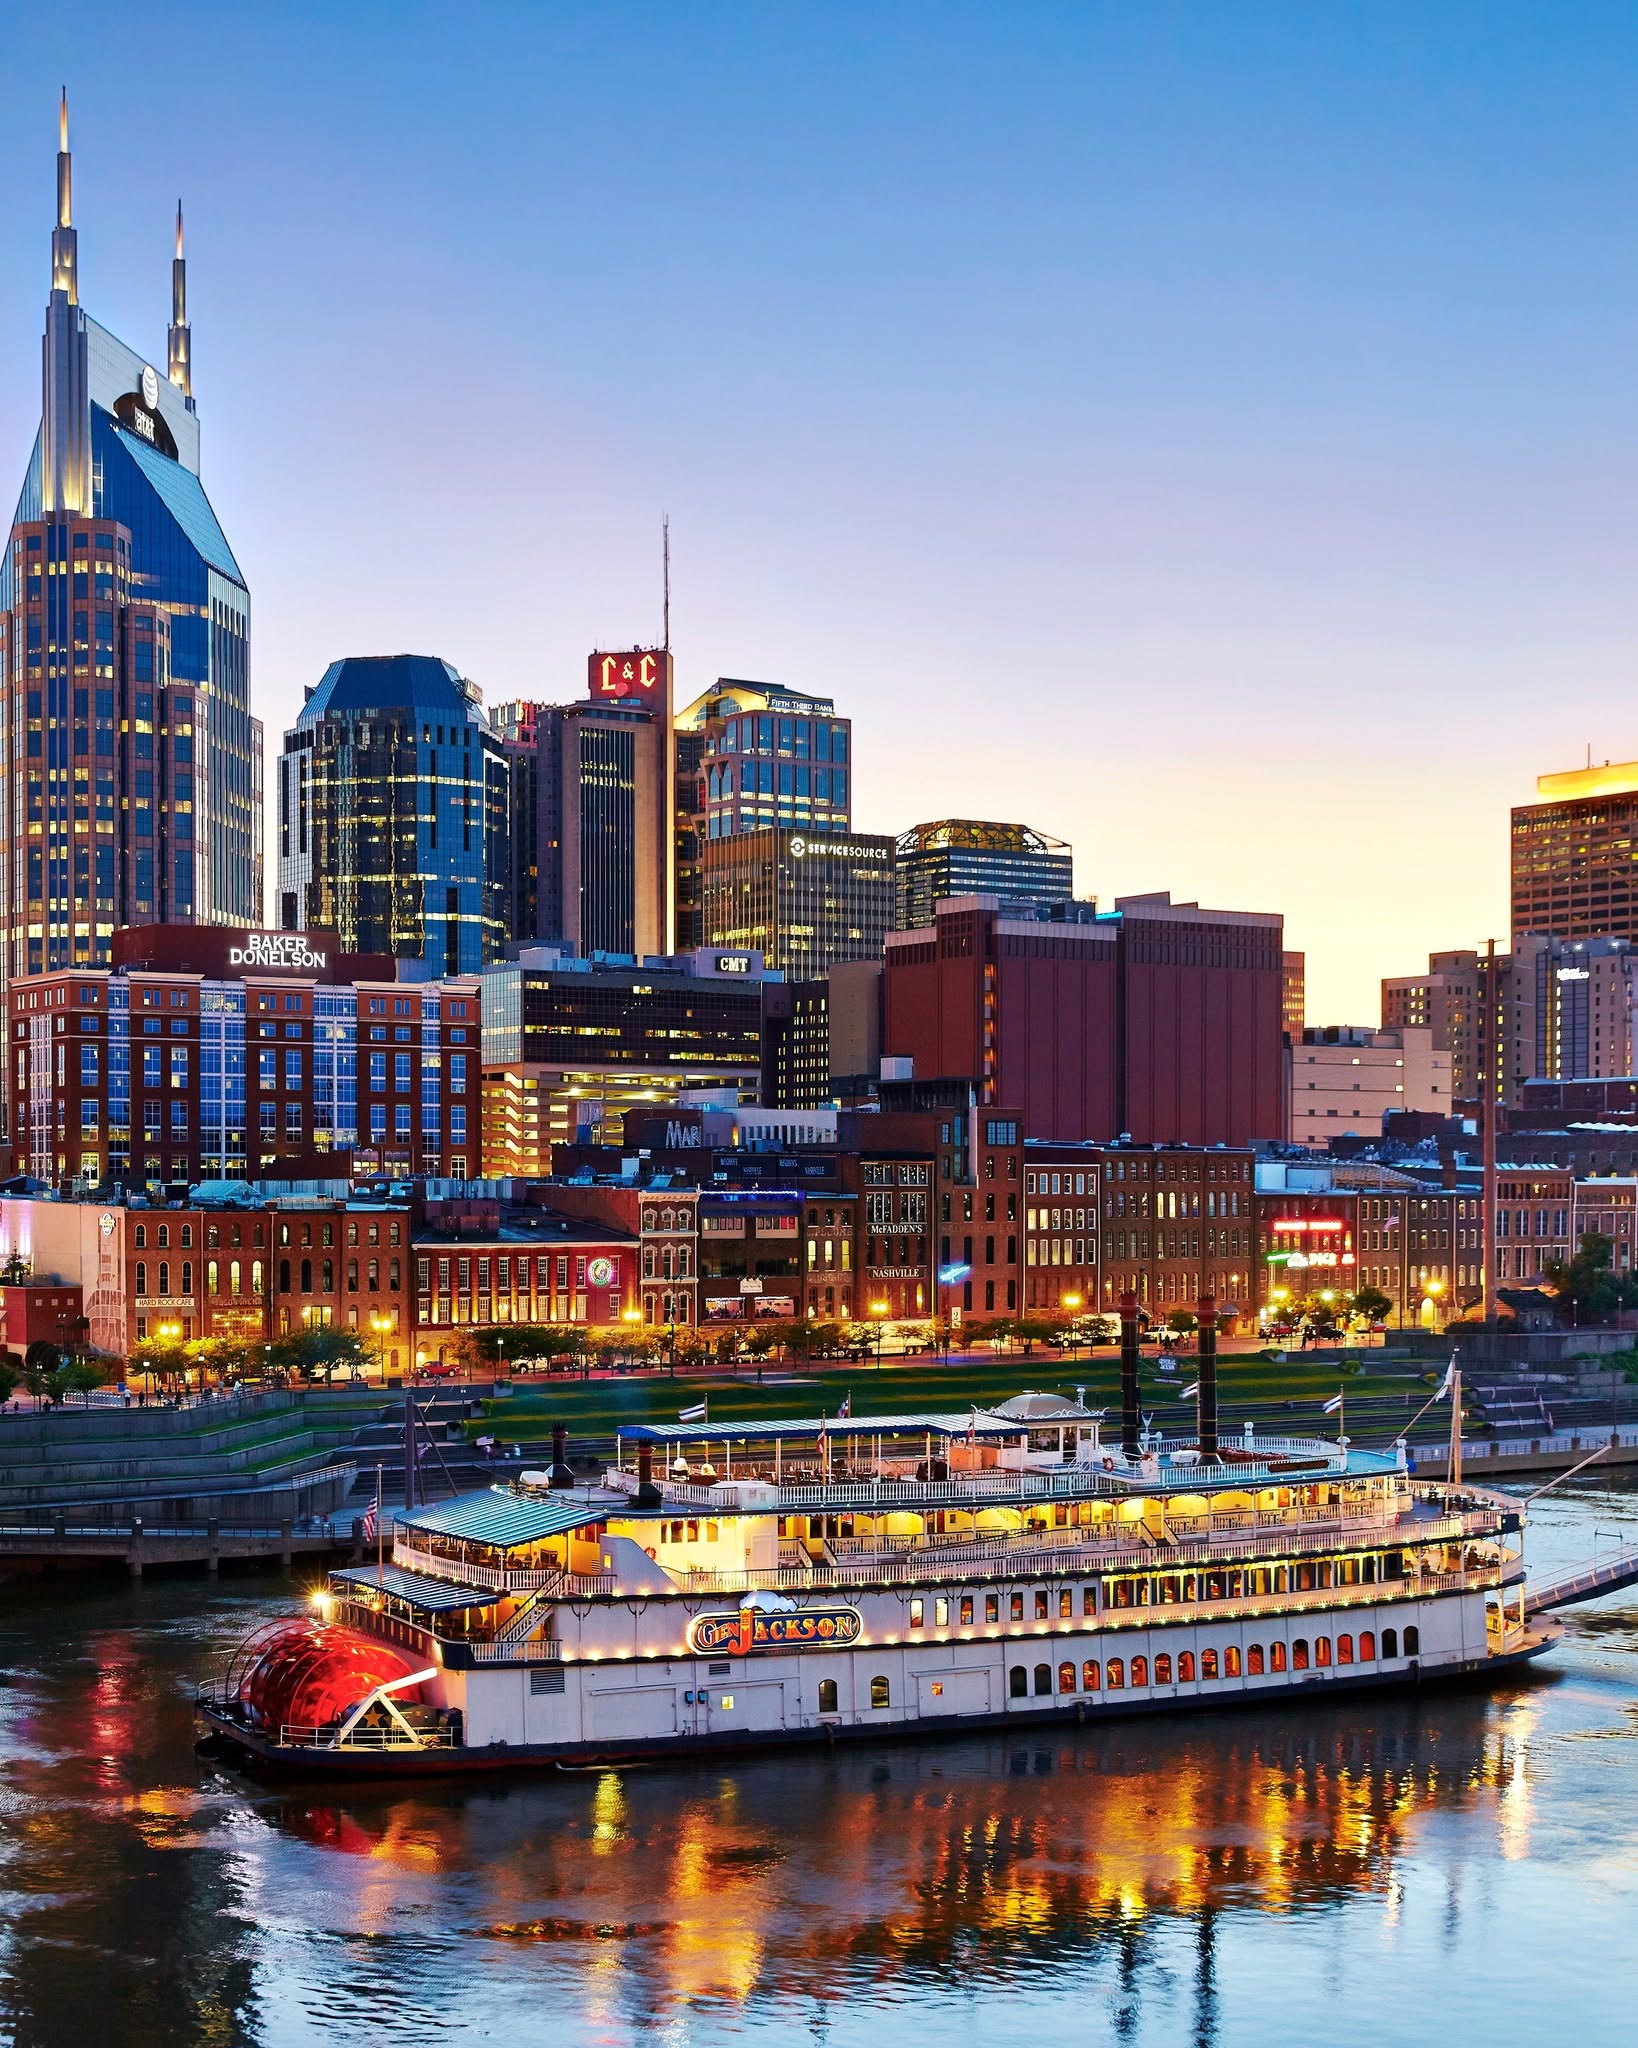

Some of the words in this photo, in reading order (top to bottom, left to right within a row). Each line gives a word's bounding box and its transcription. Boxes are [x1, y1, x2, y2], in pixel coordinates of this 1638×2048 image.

[135, 408, 155, 443] at&t
[771, 698, 790, 708] FIFTH
[792, 700, 813, 710] THIRD
[814, 702, 833, 713] BANK
[248, 934, 307, 952] BAKER
[229, 948, 326, 968] DONELSON
[720, 957, 748, 972] CMT
[871, 1224, 923, 1234] McFADDEN'S
[872, 1268, 920, 1278] NASHVILLE
[176, 1298, 192, 1306] CAFE
[697, 1619, 740, 1648] GEN
[727, 1608, 854, 1656] JACKSON
